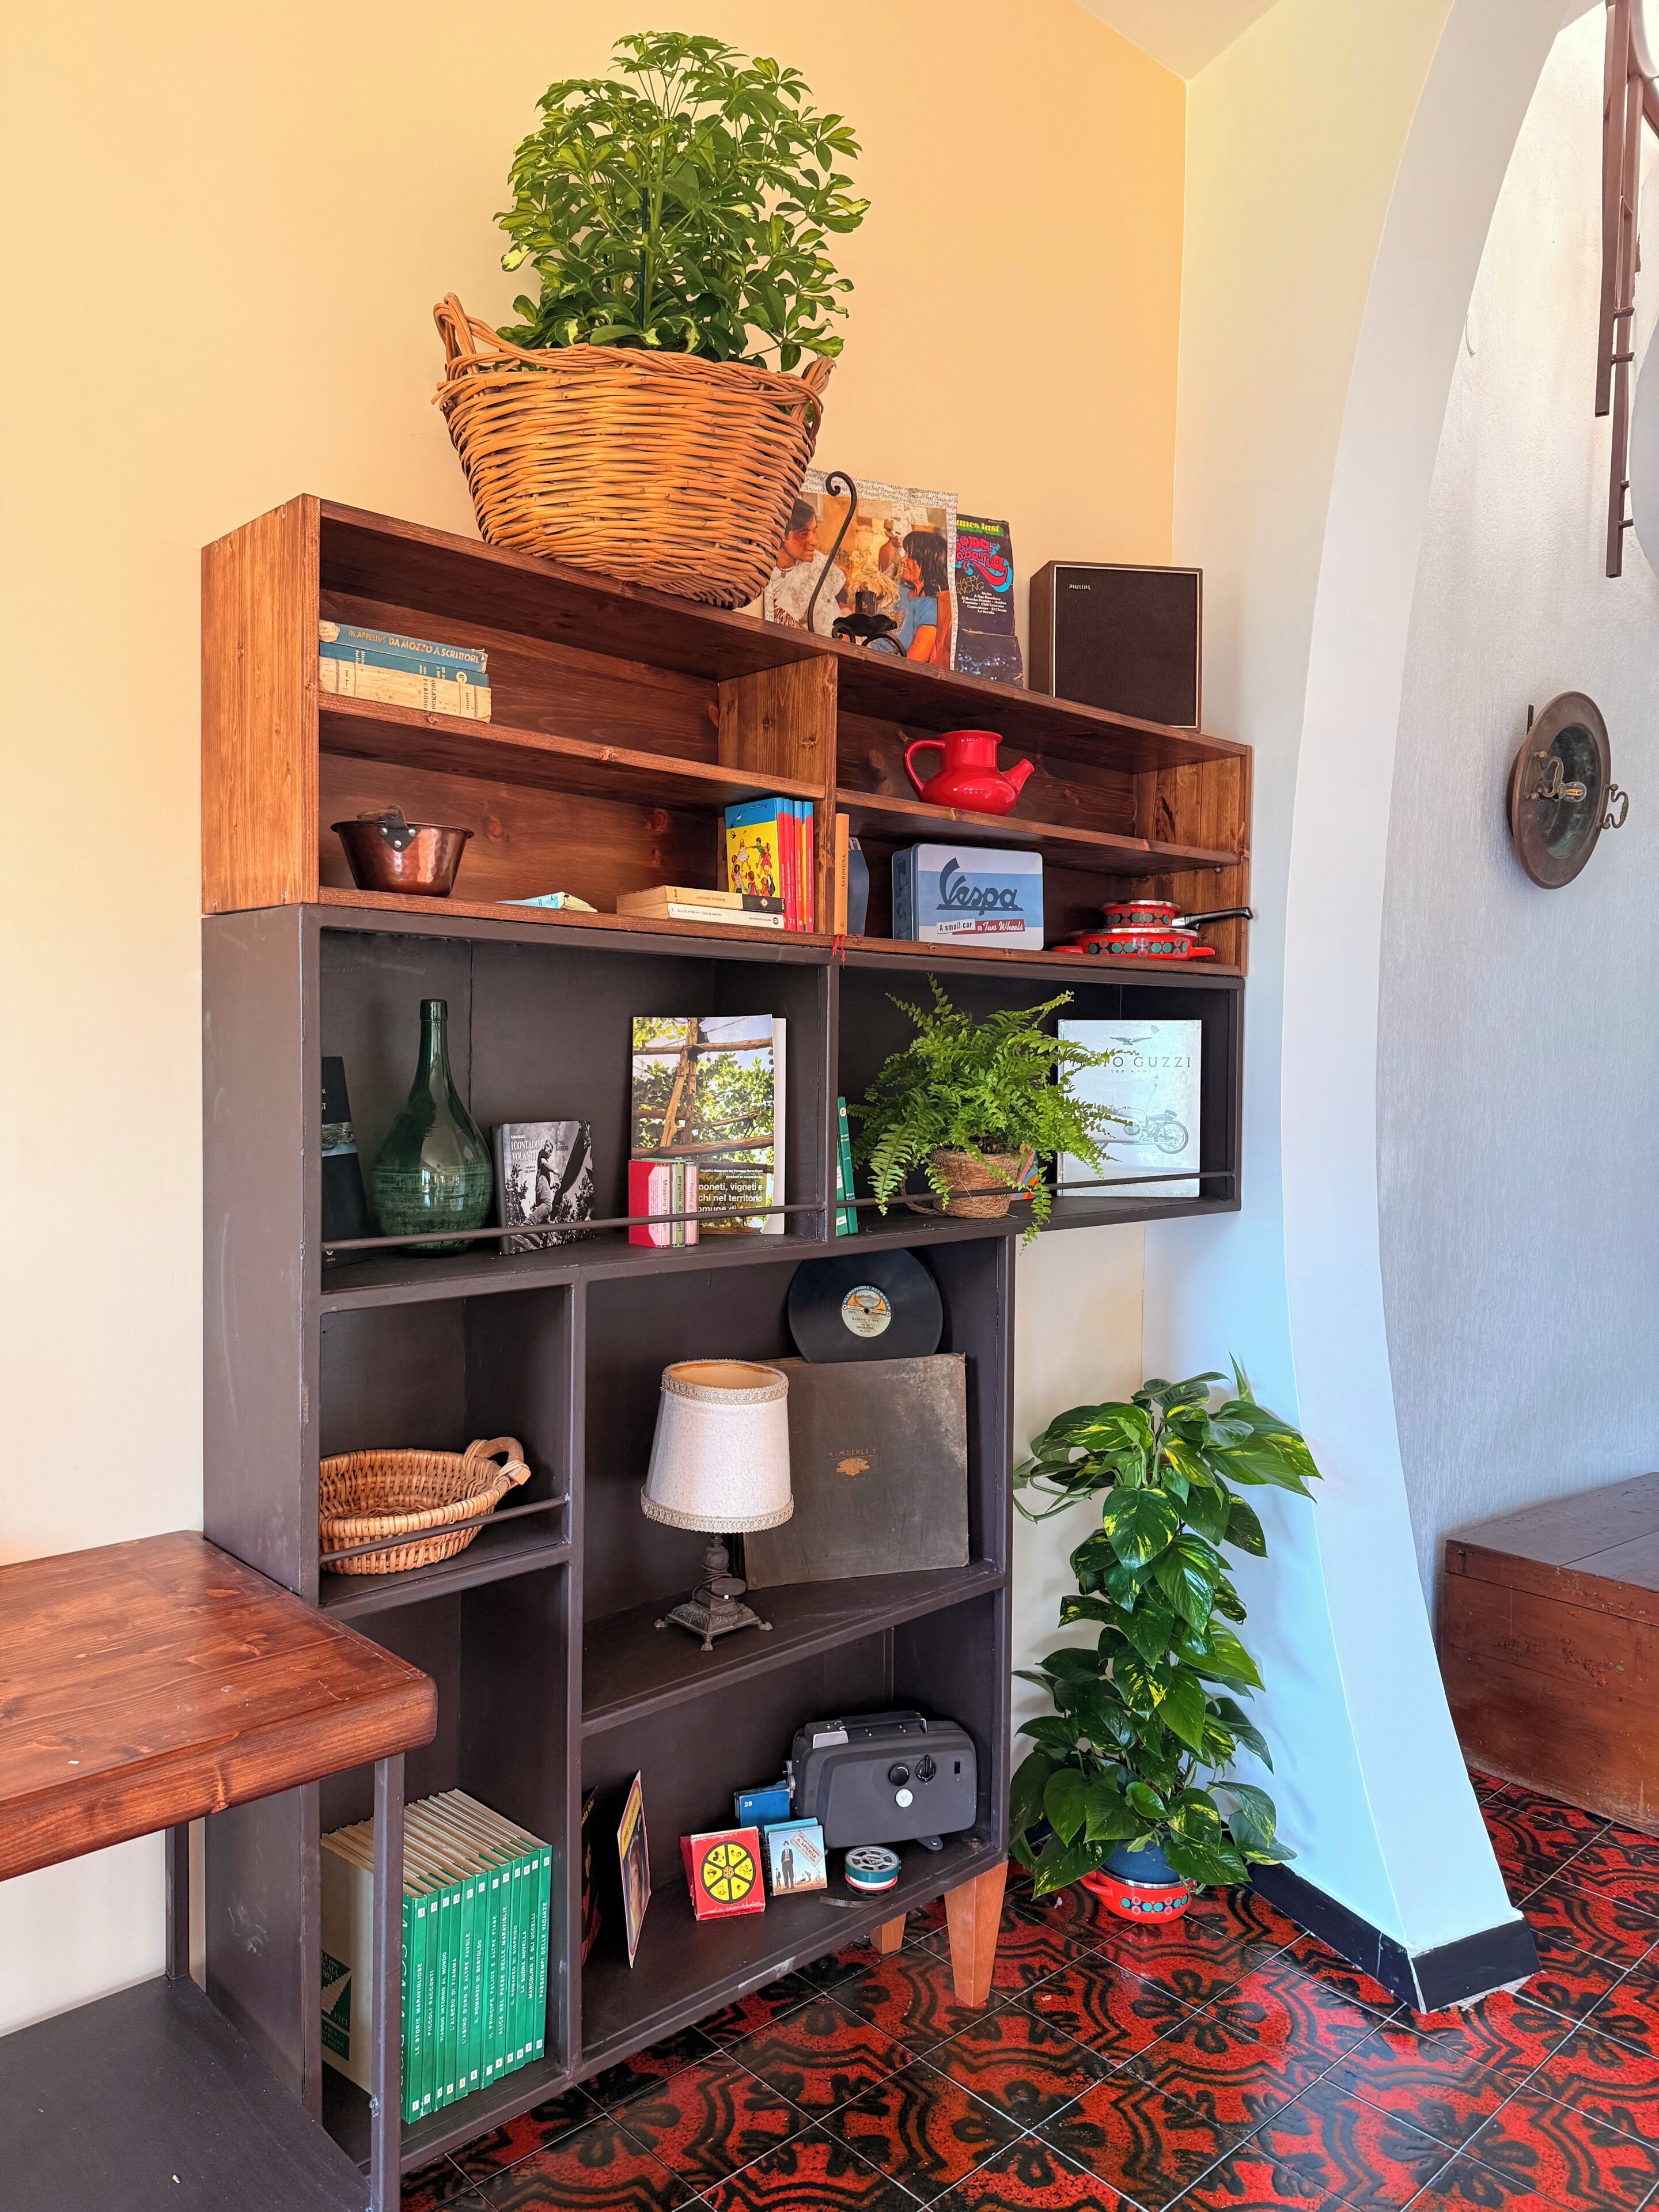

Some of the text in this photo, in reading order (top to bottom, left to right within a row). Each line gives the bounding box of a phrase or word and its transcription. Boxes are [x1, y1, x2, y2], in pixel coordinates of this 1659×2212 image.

[956, 535, 997, 552] opa-
[956, 548, 1007, 573] abana
[956, 574, 980, 585] HAPPY
[956, 582, 984, 594] ANCING
[388, 637, 400, 647] DA
[401, 639, 433, 654] MOZZO
[433, 646, 440, 655] A
[441, 648, 480, 664] SCRITTORE
[936, 857, 1024, 916] Vespa
[945, 922, 961, 930] small
[982, 921, 997, 931] Two
[998, 921, 1023, 931] Wheels
[1134, 1056, 1191, 1067] GUZZI
[511, 1140, 544, 1150] I CONTADINI
[698, 1183, 728, 1191] moneti,
[730, 1183, 756, 1192] vigneti
[871, 1287, 888, 1302] RECORD
[801, 1843, 816, 1858] APICELLA
[441, 1976, 446, 1984] AL
[451, 1988, 456, 1996] DI
[520, 1984, 525, 1993] LA
[510, 1998, 514, 2006] IL
[334, 2012, 348, 2026] UTET
[415, 2046, 420, 2055] LE
